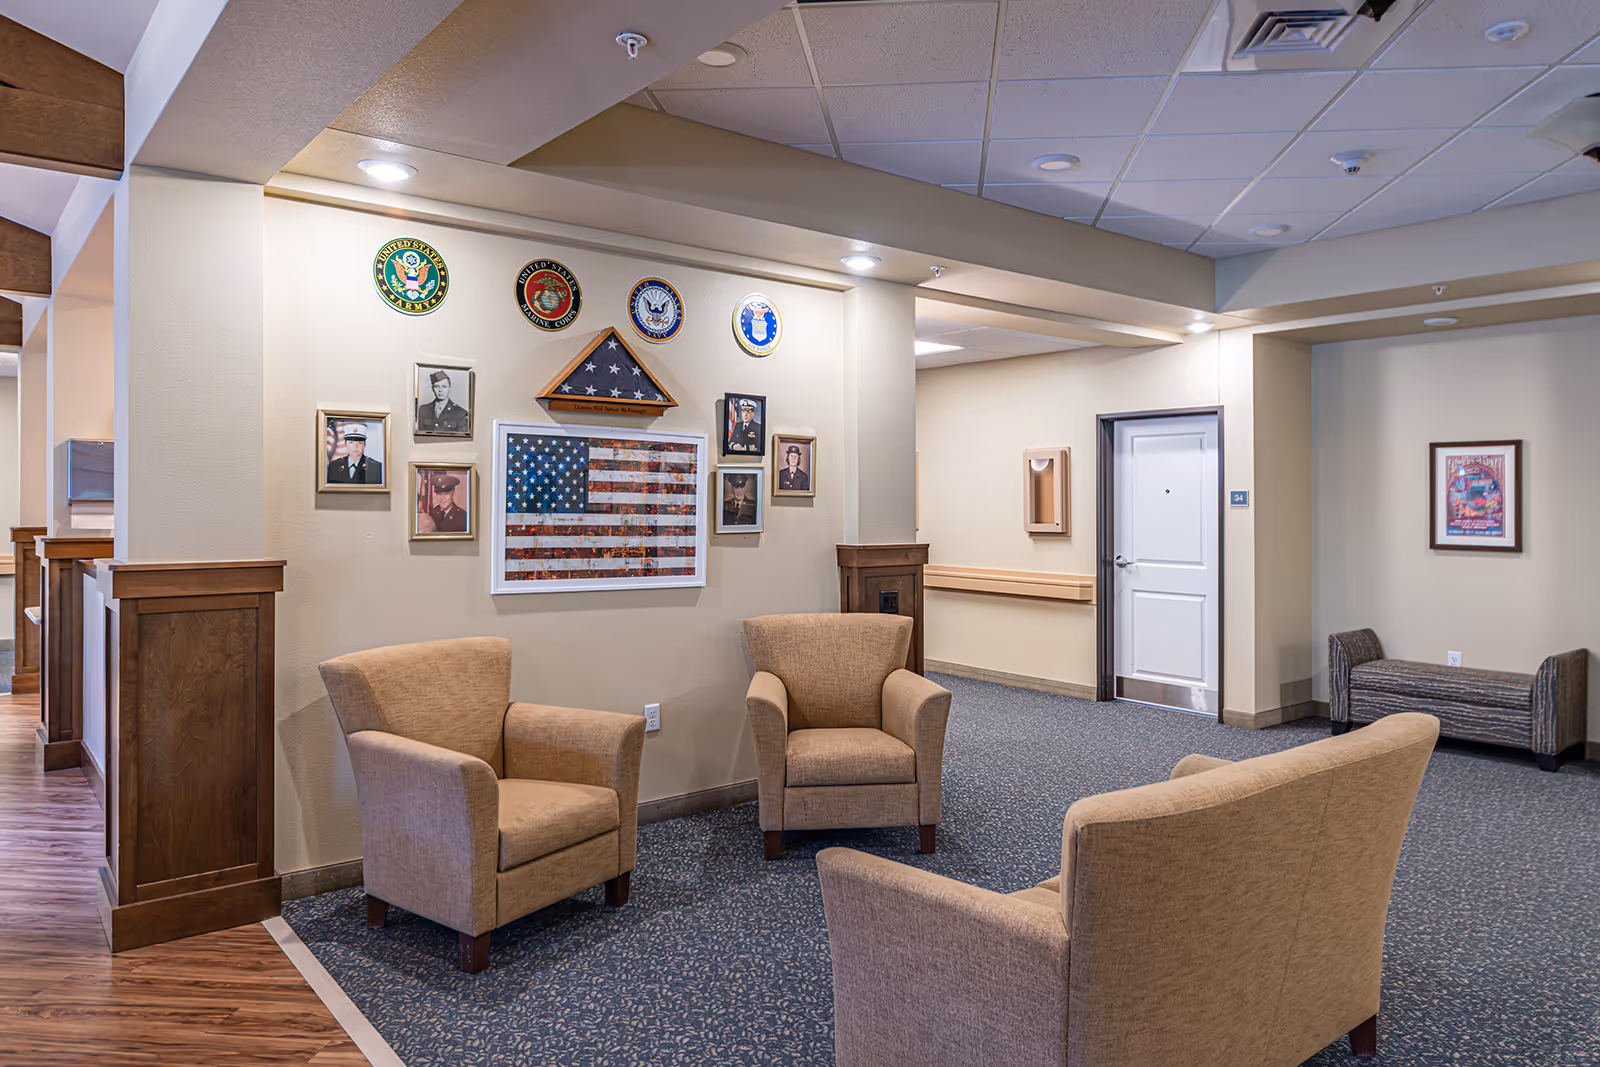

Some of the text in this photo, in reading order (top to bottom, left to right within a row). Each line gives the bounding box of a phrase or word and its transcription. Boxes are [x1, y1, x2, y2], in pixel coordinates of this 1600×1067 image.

[378, 240, 444, 269] UNITED STATES
[518, 261, 578, 292] UNITED STATES
[395, 299, 431, 310] ARMY
[521, 303, 577, 329] MARINE CORPS
[647, 330, 667, 338] NAVY
[1234, 494, 1243, 502] 34
